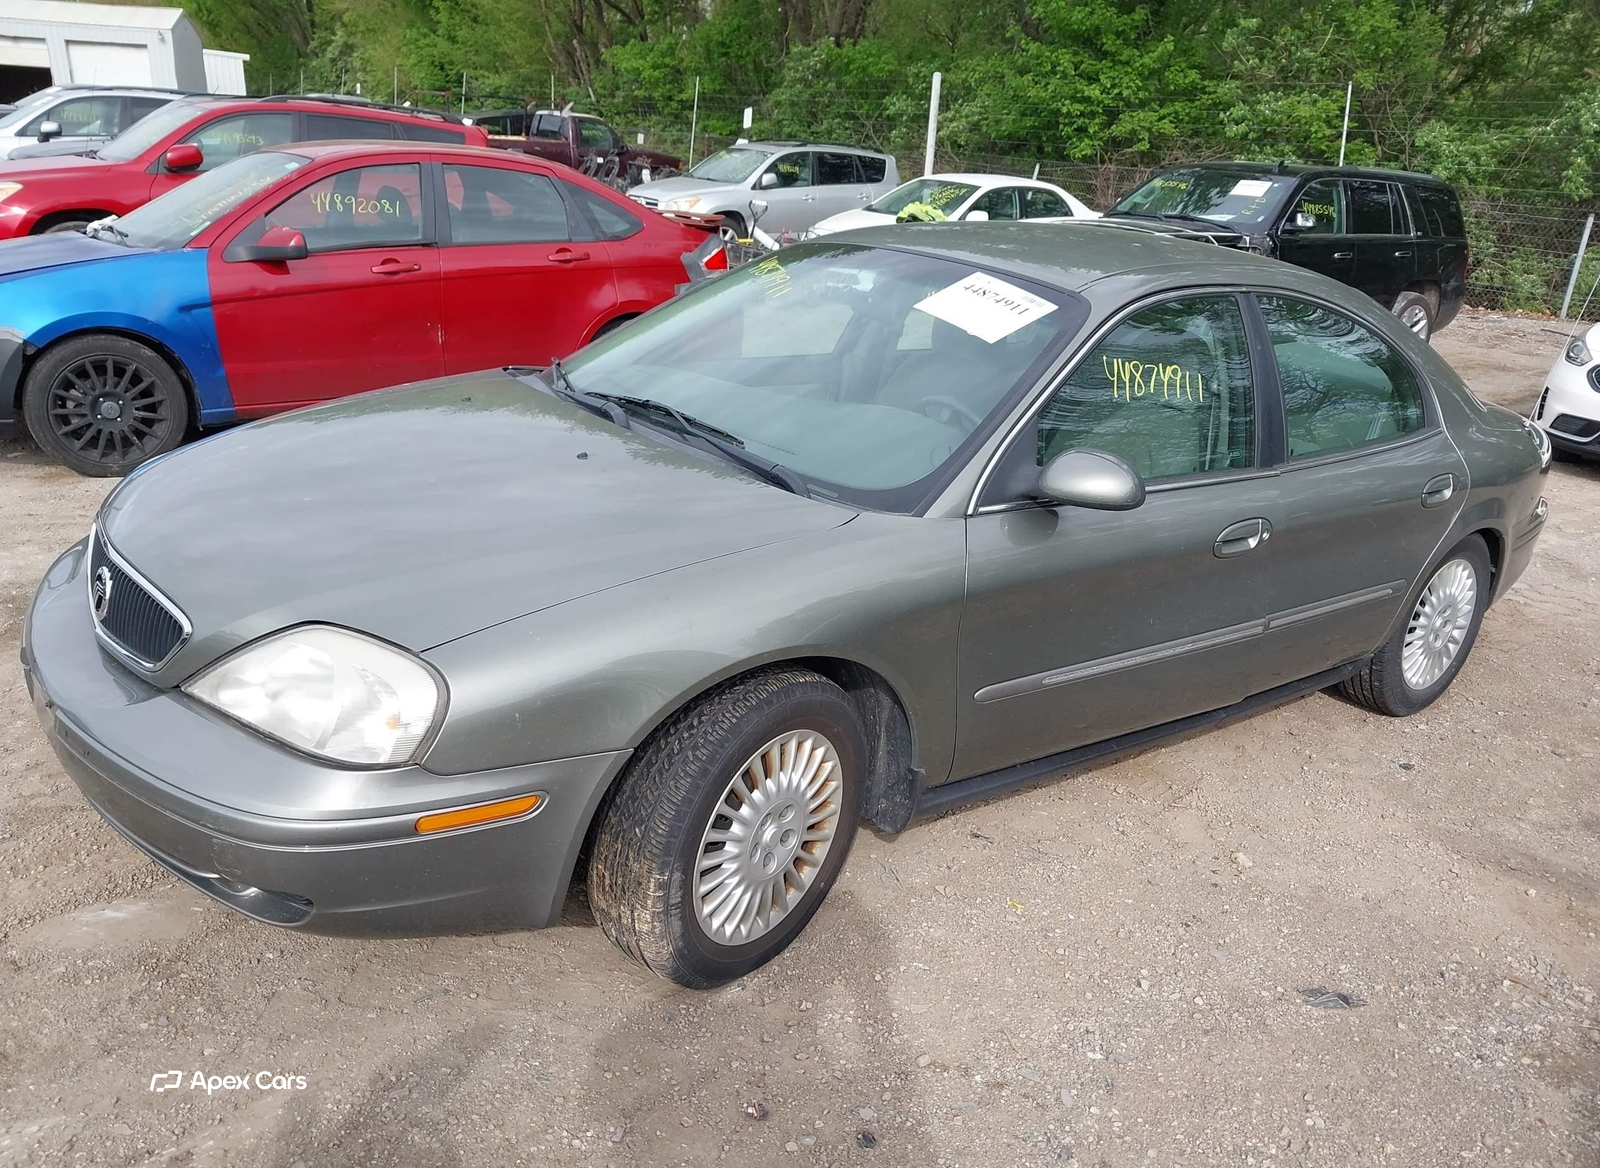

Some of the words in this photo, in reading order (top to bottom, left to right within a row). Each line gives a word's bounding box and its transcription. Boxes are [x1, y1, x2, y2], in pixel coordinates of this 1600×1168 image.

[310, 191, 400, 218] 44892081
[963, 283, 1031, 315] 44874911
[1102, 354, 1204, 403] 44874911
